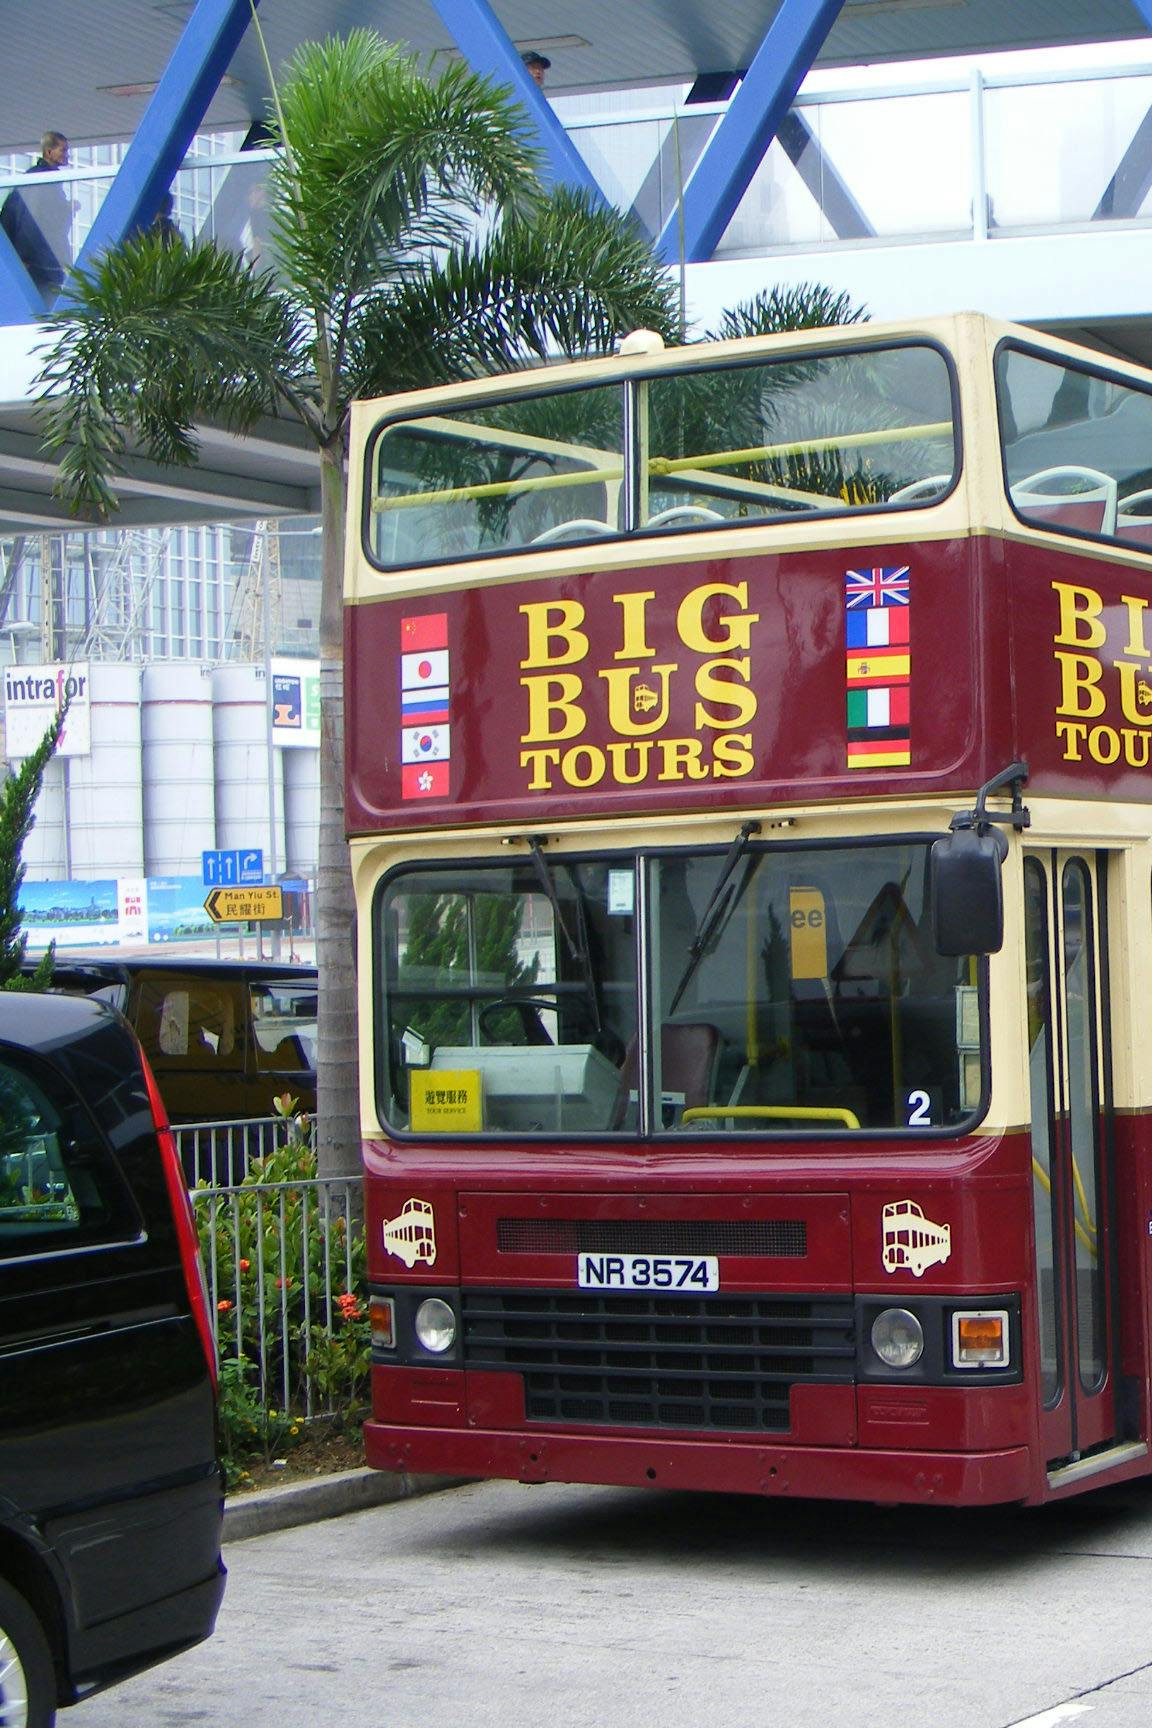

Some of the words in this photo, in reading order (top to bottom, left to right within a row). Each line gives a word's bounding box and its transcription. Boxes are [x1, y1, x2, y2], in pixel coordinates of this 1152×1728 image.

[519, 581, 759, 670] BIG
[6, 669, 86, 708] intrafor
[520, 657, 758, 743] BUS
[520, 733, 755, 791] TOURS
[225, 892, 245, 900] Man
[248, 891, 263, 900] Yiu
[908, 1090, 931, 1126] 2
[585, 1257, 625, 1285] NR
[632, 1258, 709, 1288] 3574
